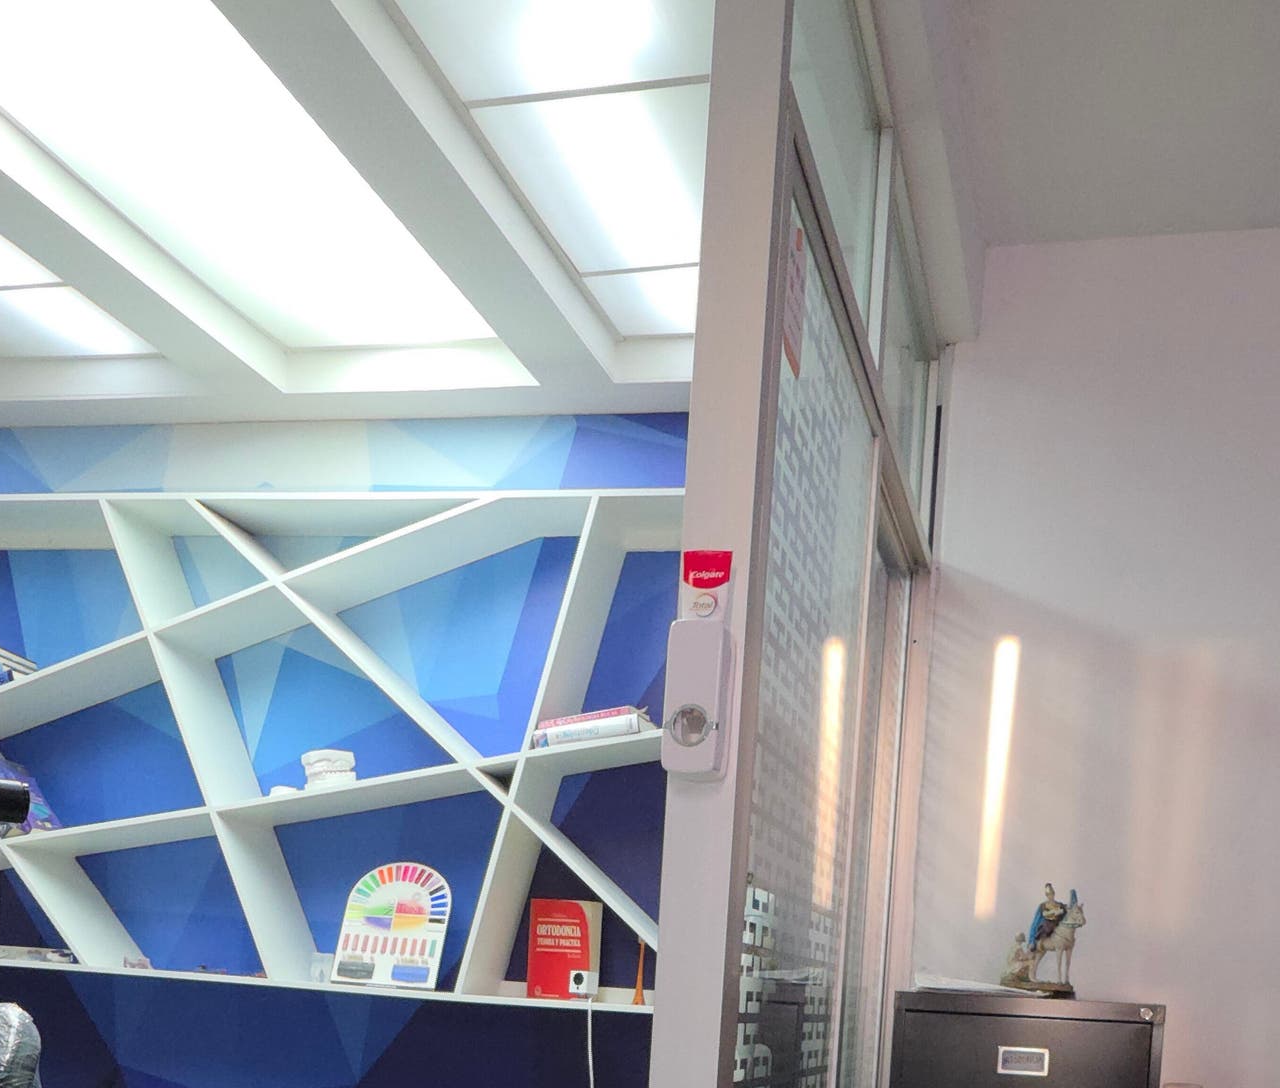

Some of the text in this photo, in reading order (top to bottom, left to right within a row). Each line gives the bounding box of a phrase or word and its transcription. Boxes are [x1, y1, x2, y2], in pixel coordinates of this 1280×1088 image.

[688, 570, 725, 580] Colgate
[692, 601, 714, 609] Total
[536, 924, 582, 937] ORTODONCIA
